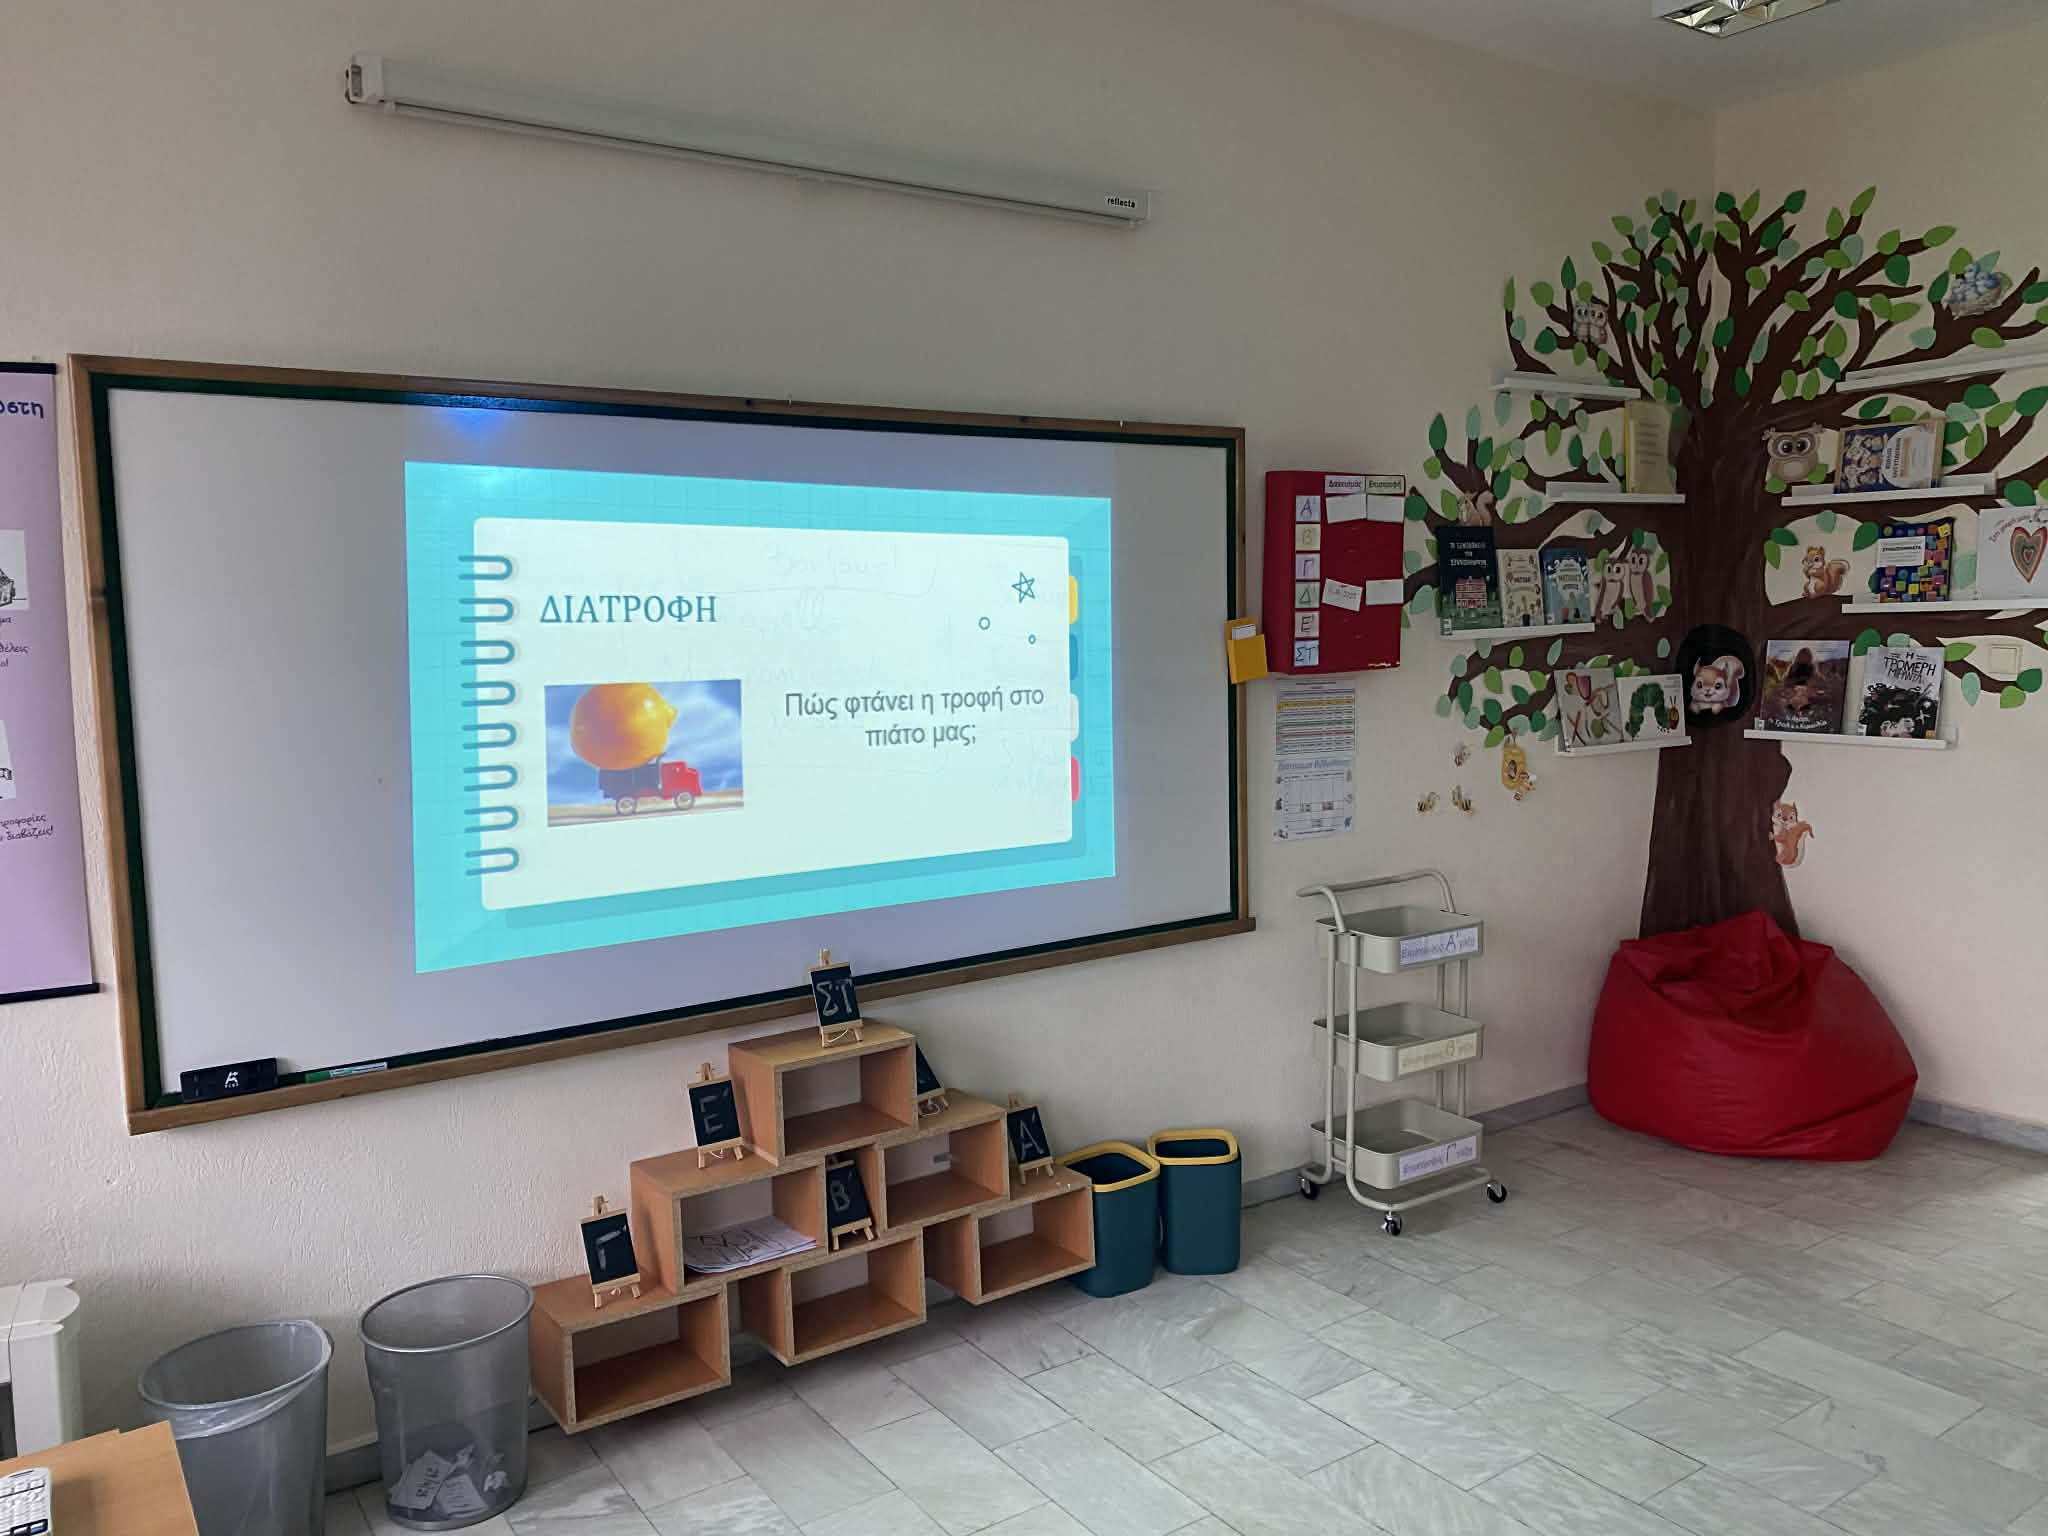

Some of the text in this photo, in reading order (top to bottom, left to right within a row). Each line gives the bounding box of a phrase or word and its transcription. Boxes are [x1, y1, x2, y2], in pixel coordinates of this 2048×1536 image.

[1107, 197, 1136, 208] reflecta
[540, 593, 718, 626] ΔΙΑΤΡΟΦΗ
[1884, 656, 1936, 676] ΤΡΟΜΕΡΗ
[1905, 652, 1914, 660] Η
[785, 686, 1045, 722] Πώς φτάνει η τροφή στο
[865, 722, 977, 750] πιάτο μας;
